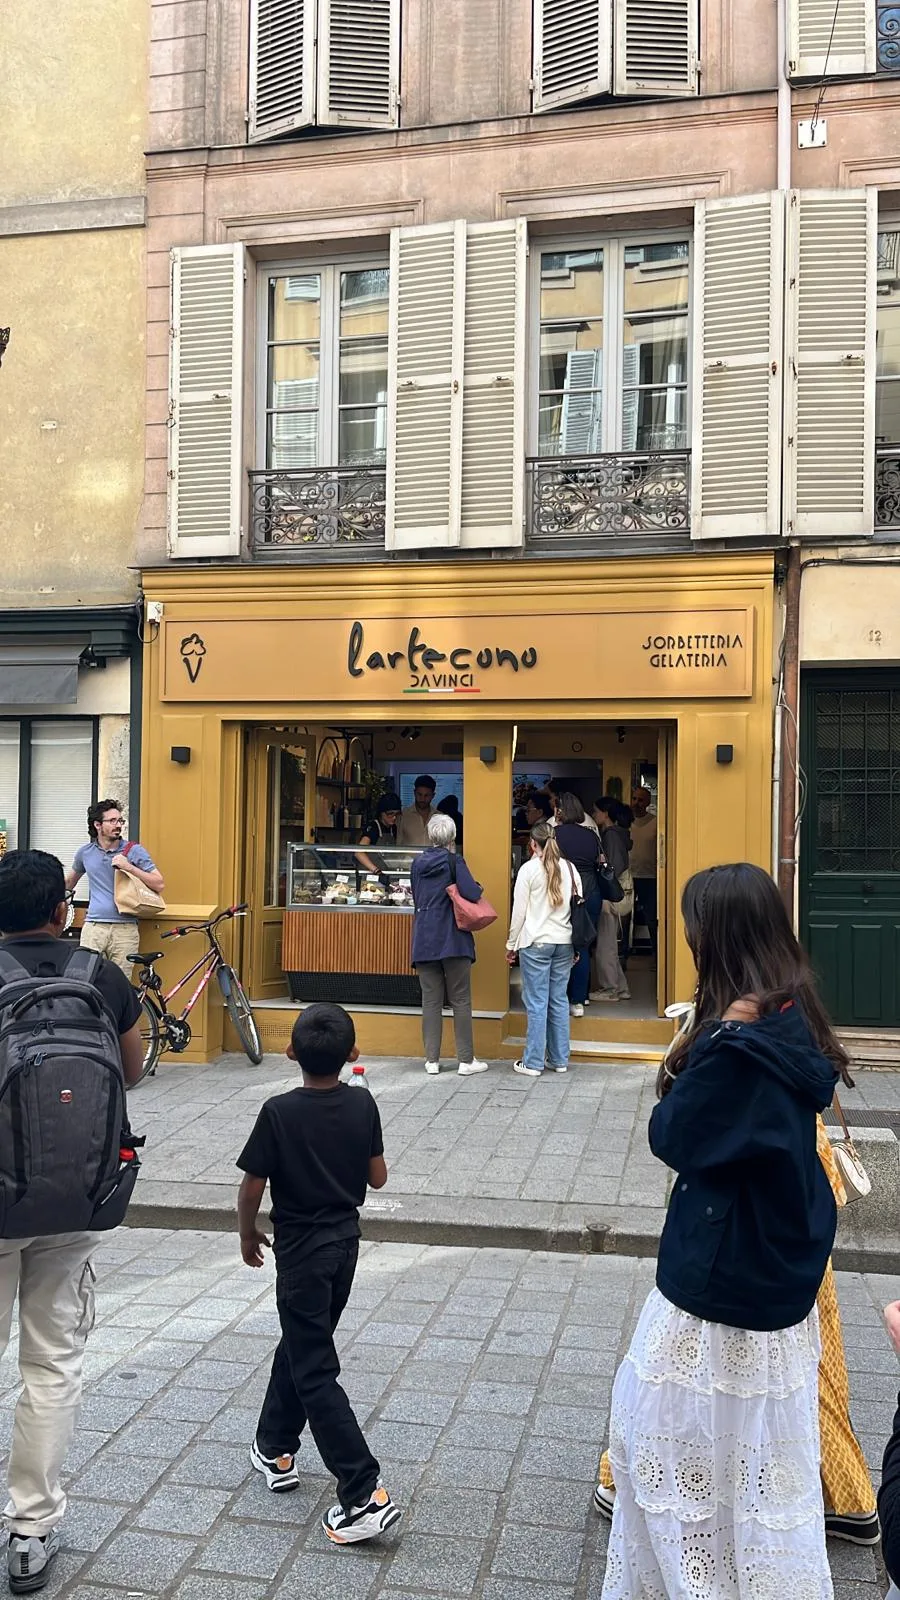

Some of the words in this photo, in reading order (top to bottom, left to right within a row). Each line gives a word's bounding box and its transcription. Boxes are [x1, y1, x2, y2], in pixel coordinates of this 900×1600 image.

[642, 634, 743, 650] SORBETTERIA
[869, 629, 881, 642] 12
[649, 653, 727, 668] GELATERIA
